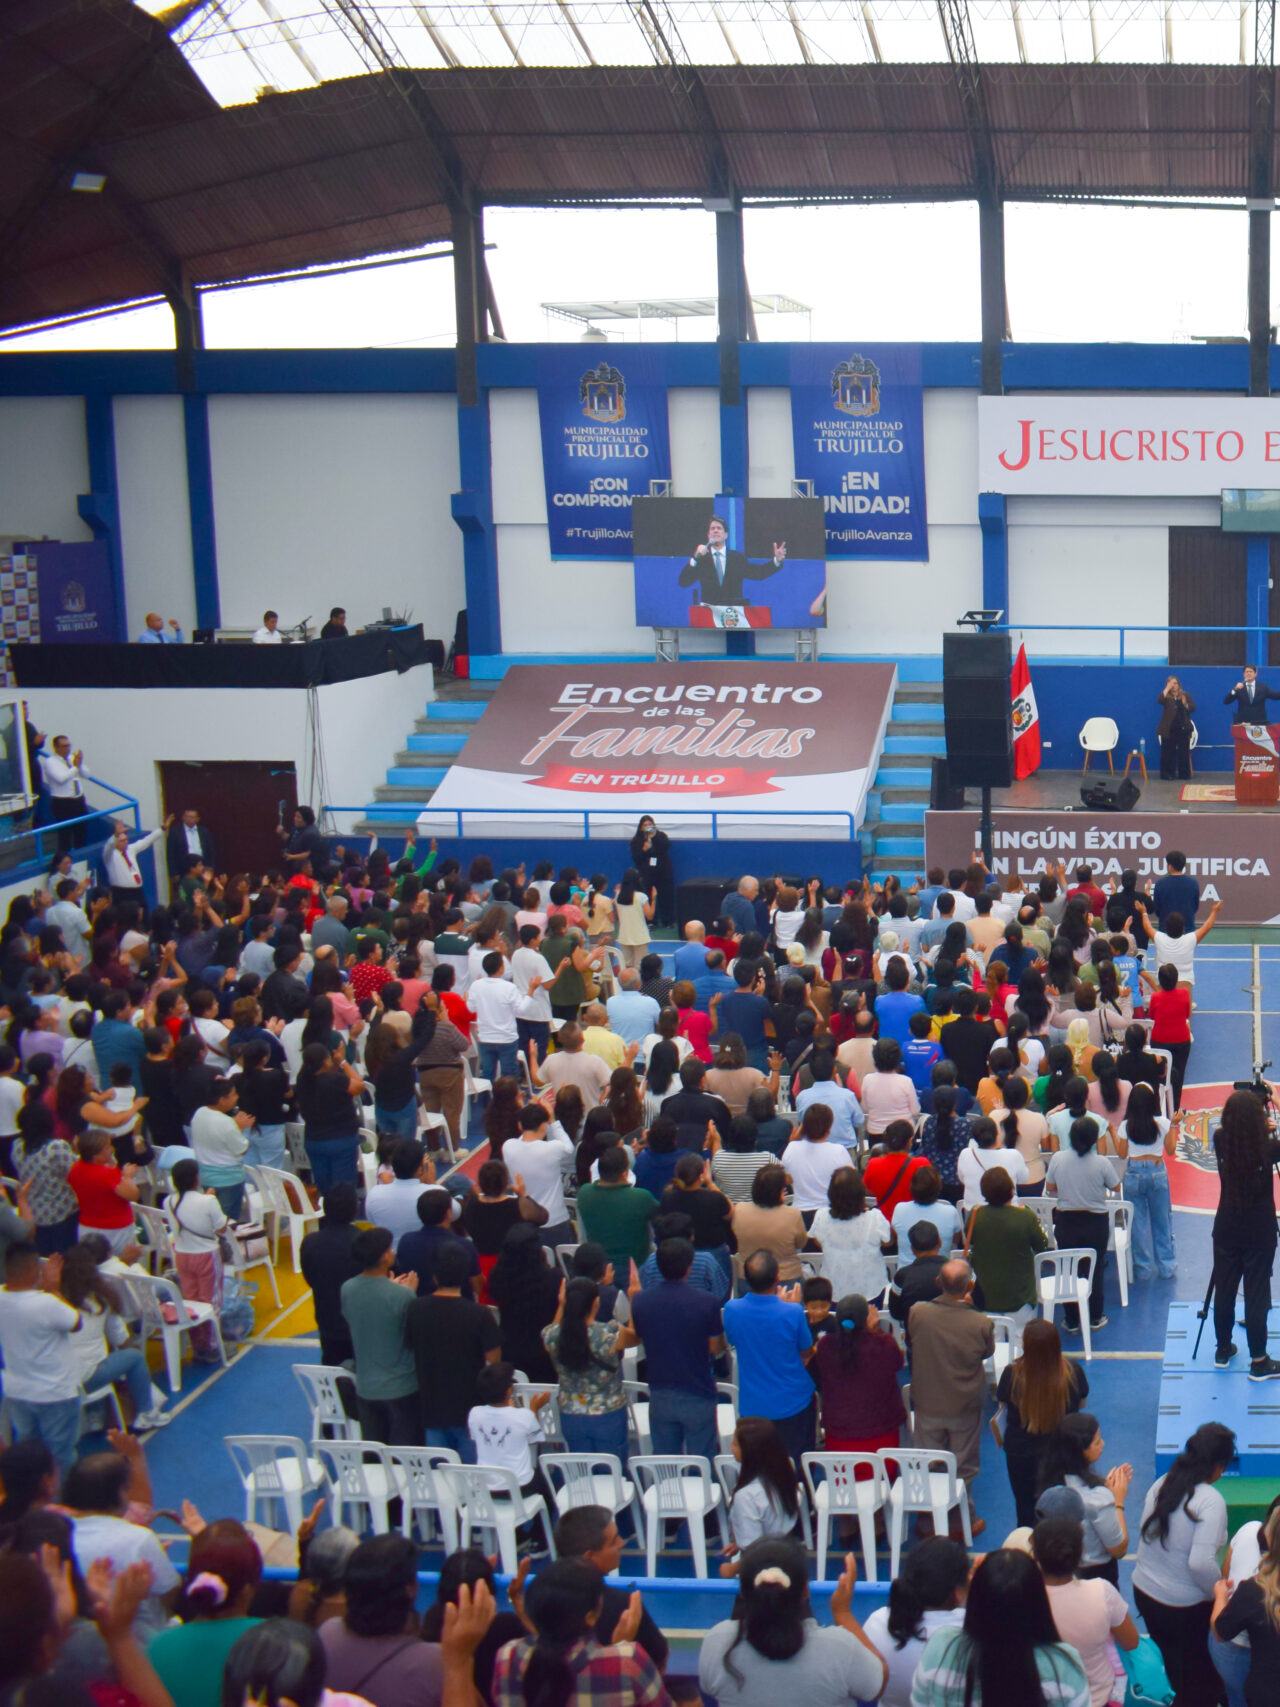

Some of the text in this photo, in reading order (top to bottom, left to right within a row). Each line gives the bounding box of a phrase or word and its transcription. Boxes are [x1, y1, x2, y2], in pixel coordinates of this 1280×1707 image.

[564, 427, 648, 436] MUNICIPALIDAD
[814, 421, 903, 430] MUNICIPALIDAD
[572, 435, 642, 443] PROVINCIAL DE
[822, 430, 895, 438] PROVINCIAL DE
[565, 443, 649, 460] TRUJILLO
[814, 438, 903, 456] TRUJILLO
[998, 420, 1244, 471] JESUCRISTO
[590, 477, 628, 493] ¡CON
[842, 472, 880, 493] ¡EN
[553, 493, 650, 507] COMPROM
[566, 528, 633, 540] #TrujilloAv
[824, 529, 913, 541] TrujilloAvanza
[557, 683, 823, 704] Encuentro
[642, 705, 705, 717] de las
[520, 704, 816, 765] Familias
[568, 773, 725, 786] EN TRUJILLO
[1084, 826, 1161, 849] ÉXITO
[1017, 857, 1047, 875] LA
[1057, 857, 1131, 875] VIDA
[1137, 857, 1270, 876] JUTIFICA
